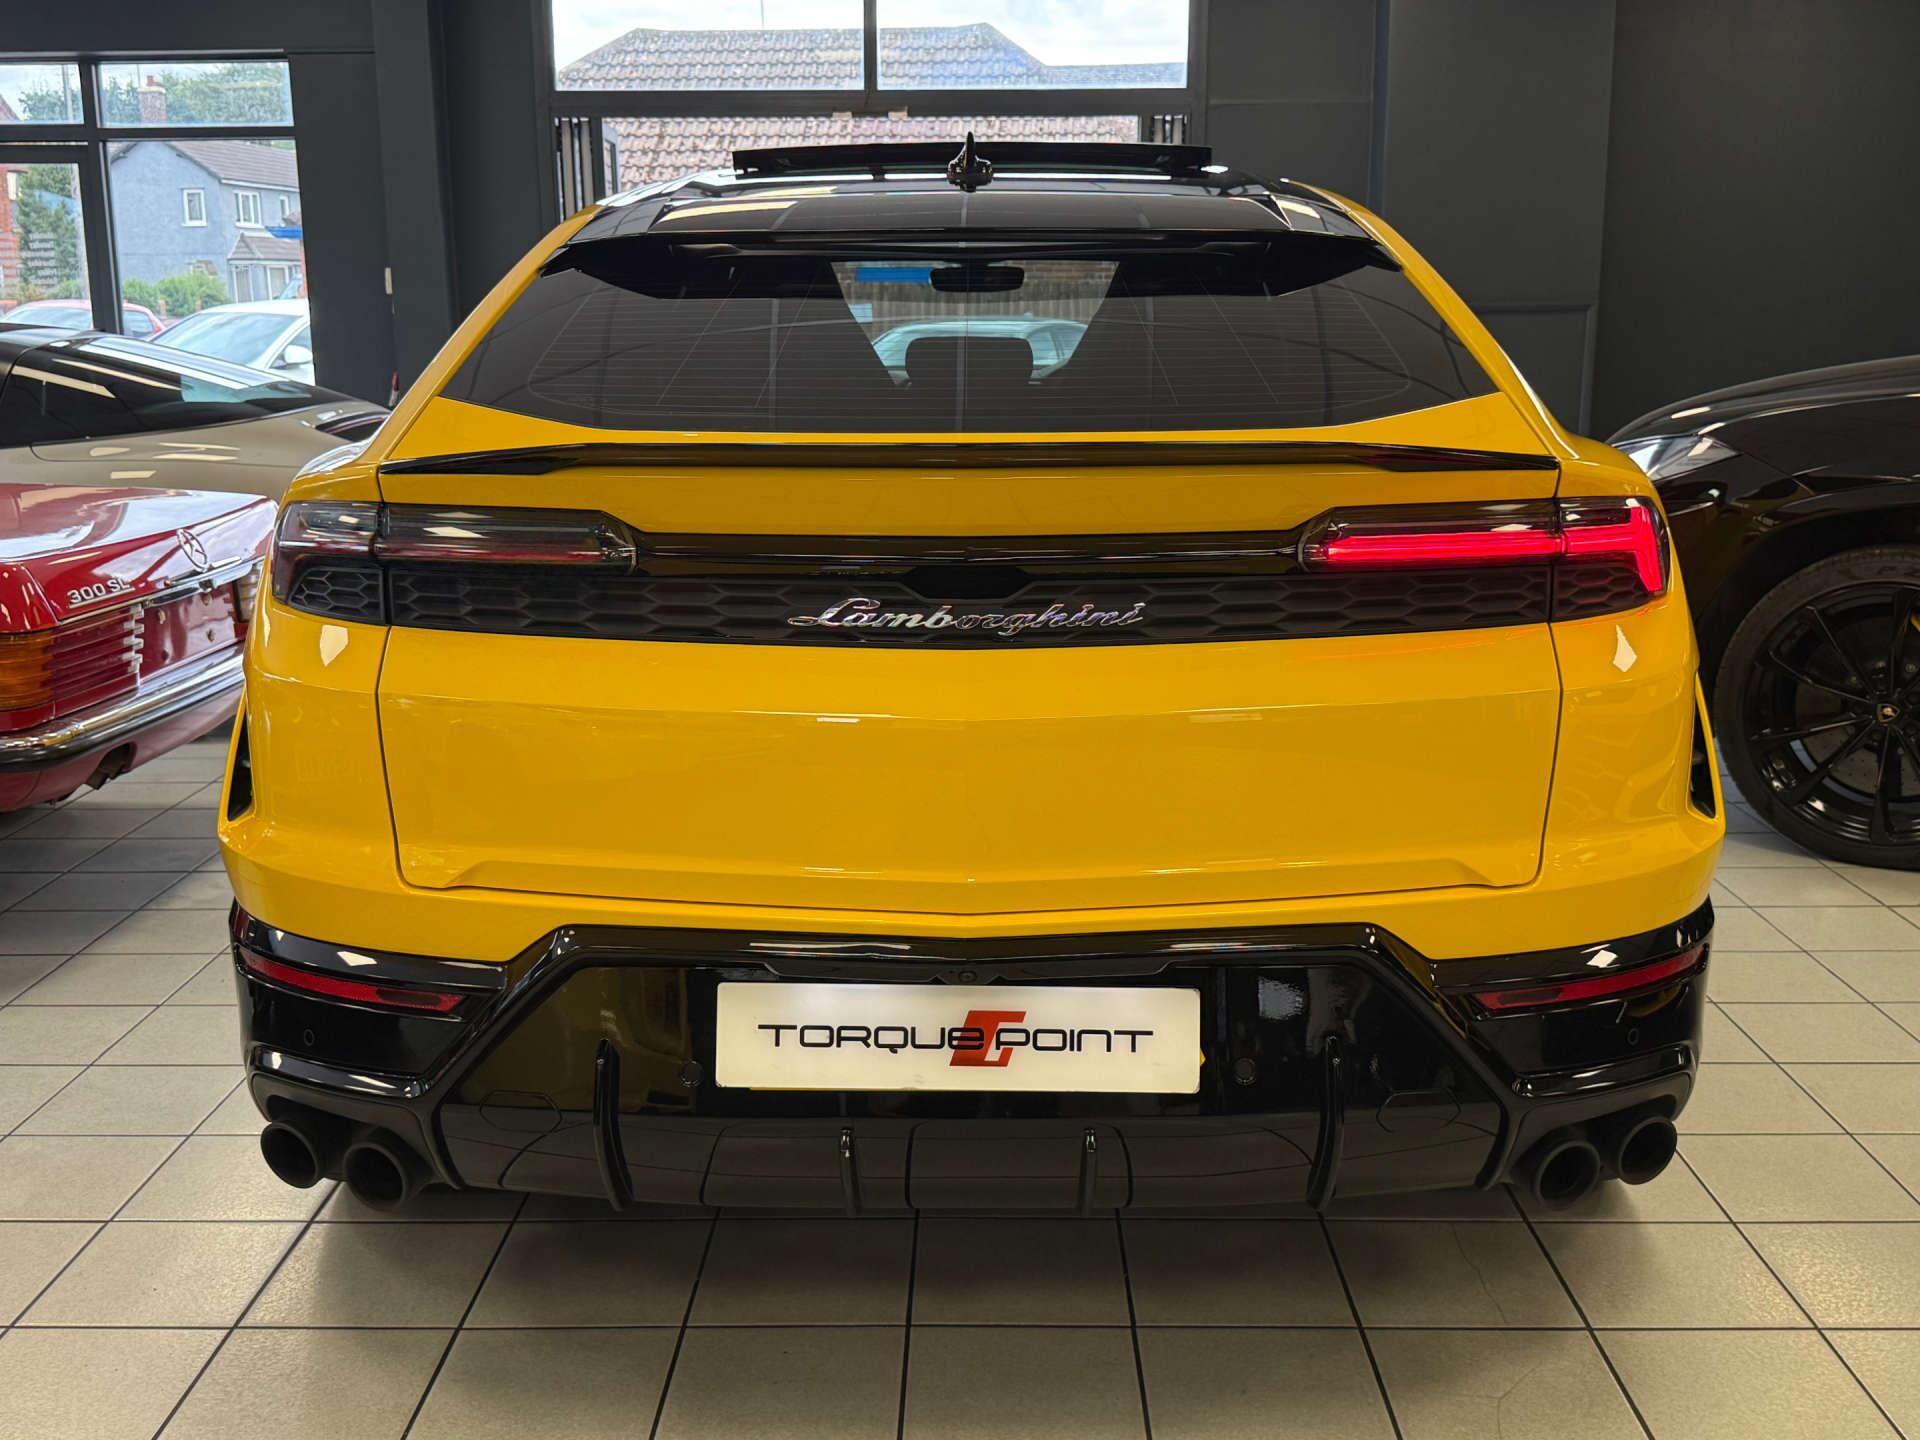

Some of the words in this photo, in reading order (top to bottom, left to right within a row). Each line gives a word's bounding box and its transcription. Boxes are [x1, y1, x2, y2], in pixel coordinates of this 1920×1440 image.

[67, 583, 106, 603] 300
[107, 578, 130, 592] SL
[787, 597, 1146, 636] Lamborghini
[757, 1023, 984, 1054] TORQUE
[995, 1027, 1154, 1054] POINT
